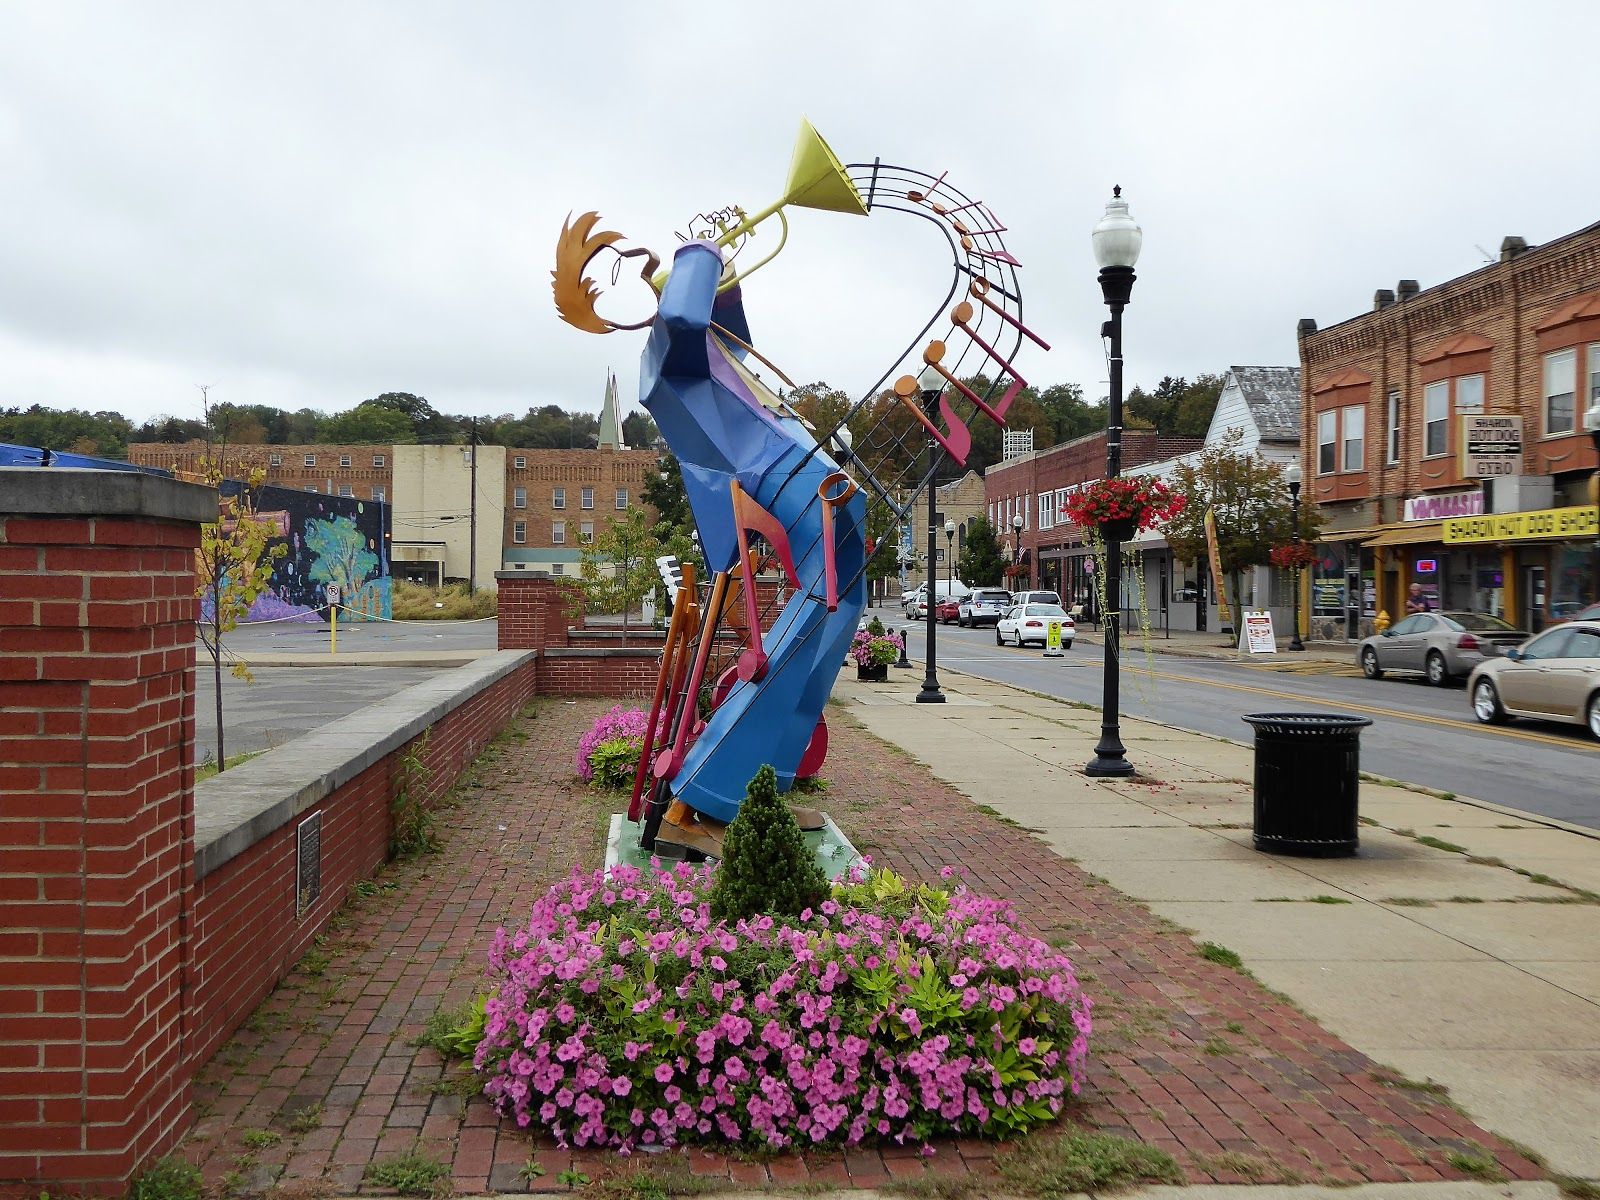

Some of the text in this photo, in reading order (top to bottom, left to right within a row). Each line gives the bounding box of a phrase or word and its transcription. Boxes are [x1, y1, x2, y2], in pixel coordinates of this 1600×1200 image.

[1474, 418, 1513, 428] SHARON
[1469, 429, 1519, 441] HOT DOG
[1477, 461, 1512, 475] GYRO
[1450, 510, 1598, 539] SHARON HOT DOG SHOP
